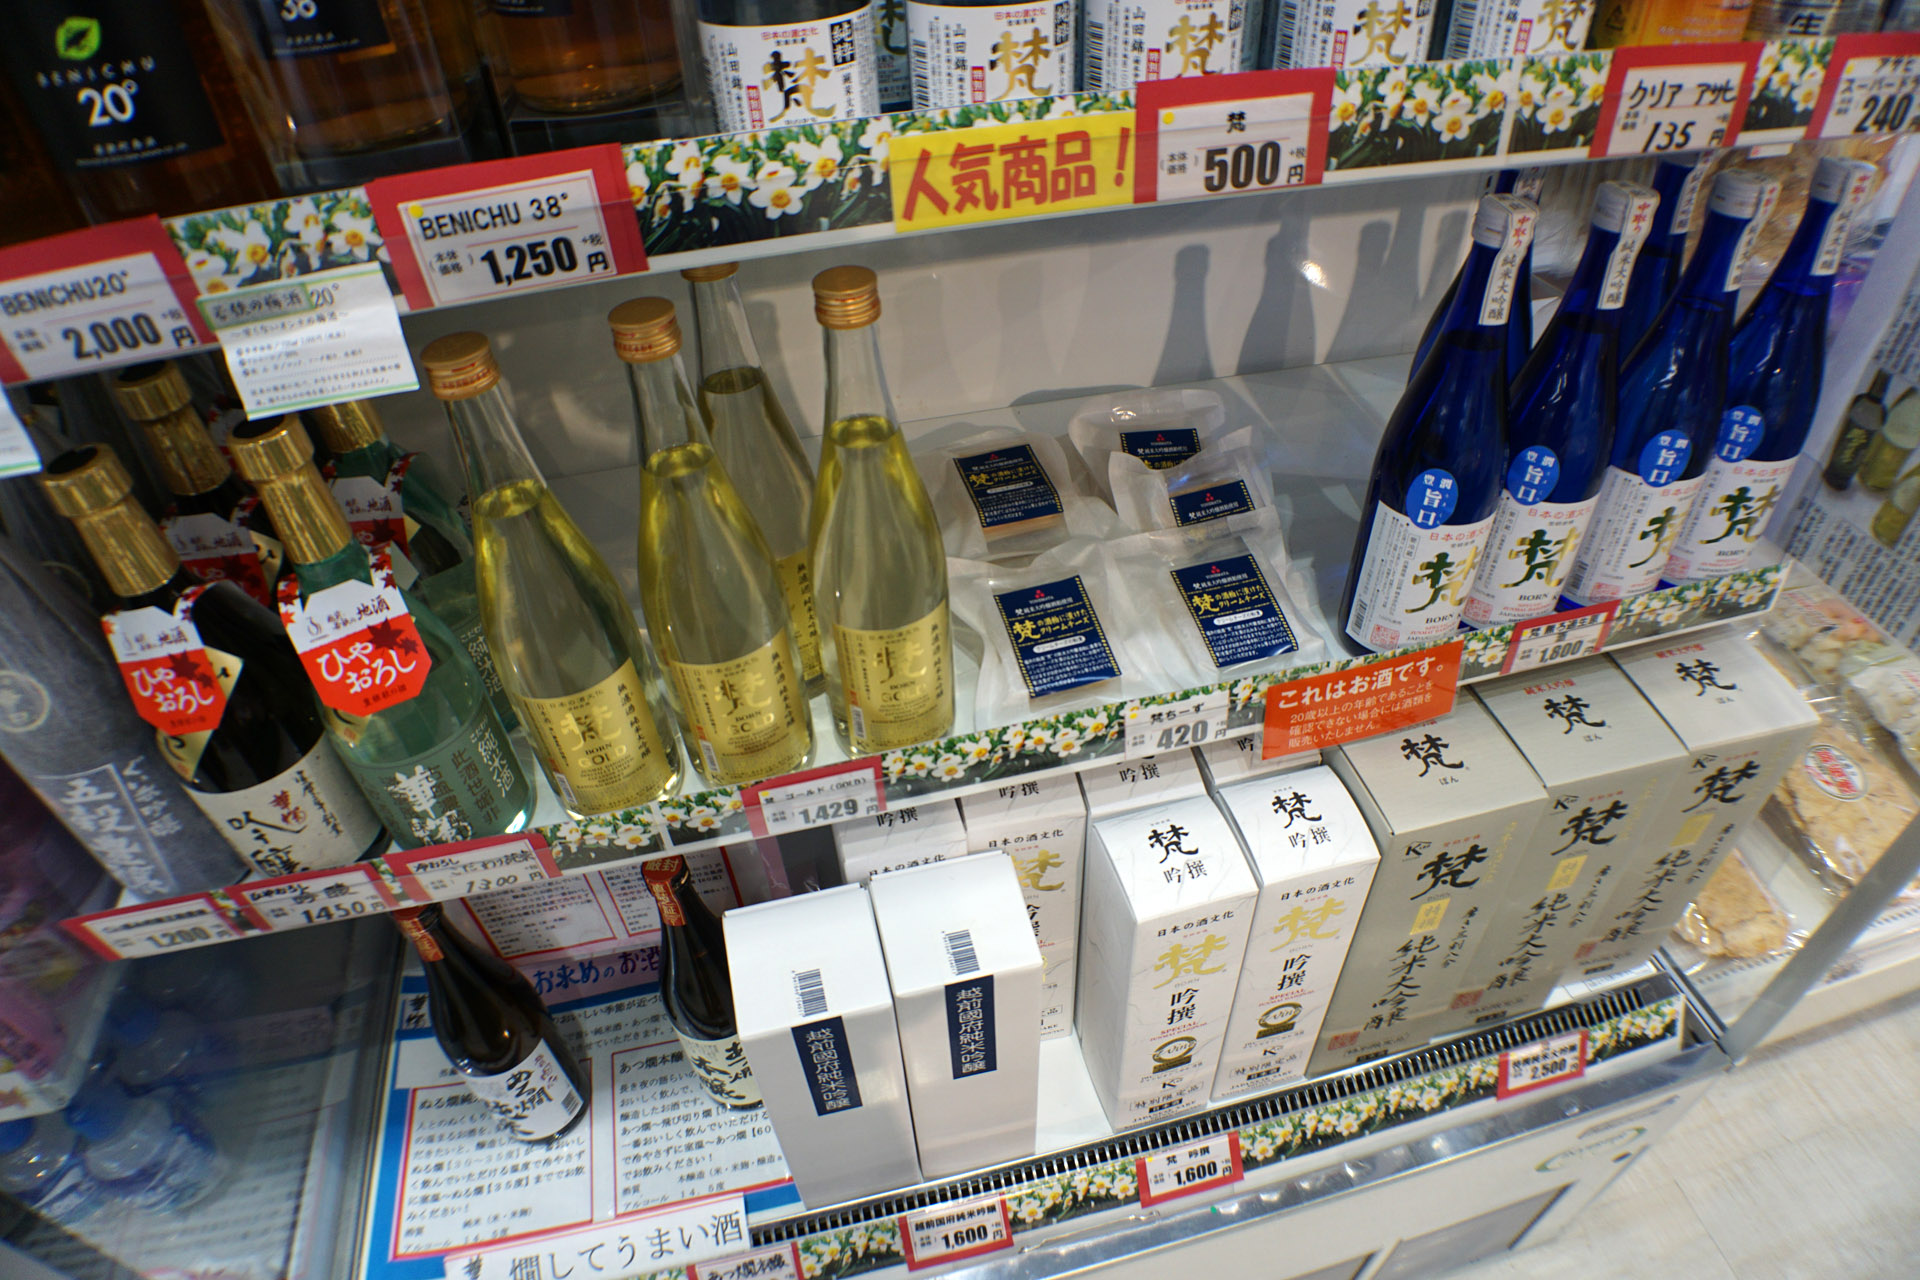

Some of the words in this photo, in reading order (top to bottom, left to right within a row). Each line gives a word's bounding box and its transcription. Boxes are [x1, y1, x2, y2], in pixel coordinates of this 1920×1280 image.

[1165, 12, 1226, 78] 梵
[1352, 0, 1413, 66] 梵
[37, 55, 157, 88] BENICHU
[988, 26, 1053, 101] 梵
[761, 47, 837, 124] 梵
[1853, 94, 1915, 133] 240
[1642, 121, 1696, 152] 135
[1204, 141, 1281, 192] 500
[1287, 165, 1304, 185] 円
[418, 203, 521, 241] BENICHU
[531, 192, 569, 223] 38°
[480, 235, 578, 287] 1,250
[587, 251, 610, 273] 円
[62, 312, 163, 360] 2,000
[171, 325, 196, 348] 円
[1517, 465, 1544, 503] 旨口
[1416, 488, 1443, 527] 旨口
[1698, 484, 1782, 545] 梵
[1499, 528, 1581, 588] 梵
[1405, 546, 1482, 614] 梵
[1191, 593, 1220, 616] 梵
[1218, 591, 1267, 609] クリームチーズ
[1012, 620, 1041, 643] 梵
[1040, 617, 1090, 635] クリームチーズ
[316, 642, 374, 682] ひや
[345, 649, 417, 694] おろし
[1675, 658, 1738, 697] 梵
[131, 667, 176, 697] ひや
[154, 680, 215, 714] おろし
[1278, 657, 1444, 709] これはお酒です。
[1289, 693, 1433, 737] 確認できない場合には酒類を
[1290, 680, 1434, 723] 20歳以上の年齢であることを
[1543, 695, 1607, 735] 梵
[1156, 720, 1209, 750] 420
[1288, 722, 1382, 748] 販売いたしません。
[1119, 763, 1161, 783] 吟撰
[1400, 734, 1465, 777] 梵
[1682, 760, 1761, 813] 梵
[799, 799, 859, 824] 1,429
[1272, 791, 1323, 829] 梵
[1551, 800, 1629, 856] 梵
[988, 828, 1065, 848] 日本の酒文化
[1148, 824, 1199, 863] 梵
[1288, 826, 1332, 848] 吟撰
[465, 875, 519, 893] 1300
[1163, 859, 1208, 884] 吟撰
[1281, 876, 1355, 901] 日本の酒文化
[1410, 844, 1489, 901] 梵
[301, 901, 366, 923] 1450
[1157, 910, 1235, 937] 日本の酒文化
[1269, 897, 1346, 953] 梵
[1152, 933, 1230, 990] 梵
[1277, 953, 1313, 991] 吟撰
[1167, 987, 1200, 1026] 吟撰
[1530, 1058, 1568, 1081] 2,500
[1174, 1161, 1218, 1186] 1,600
[1222, 1165, 1233, 1177] 円
[942, 1224, 988, 1250] 1,600
[992, 1228, 1003, 1241] 円
